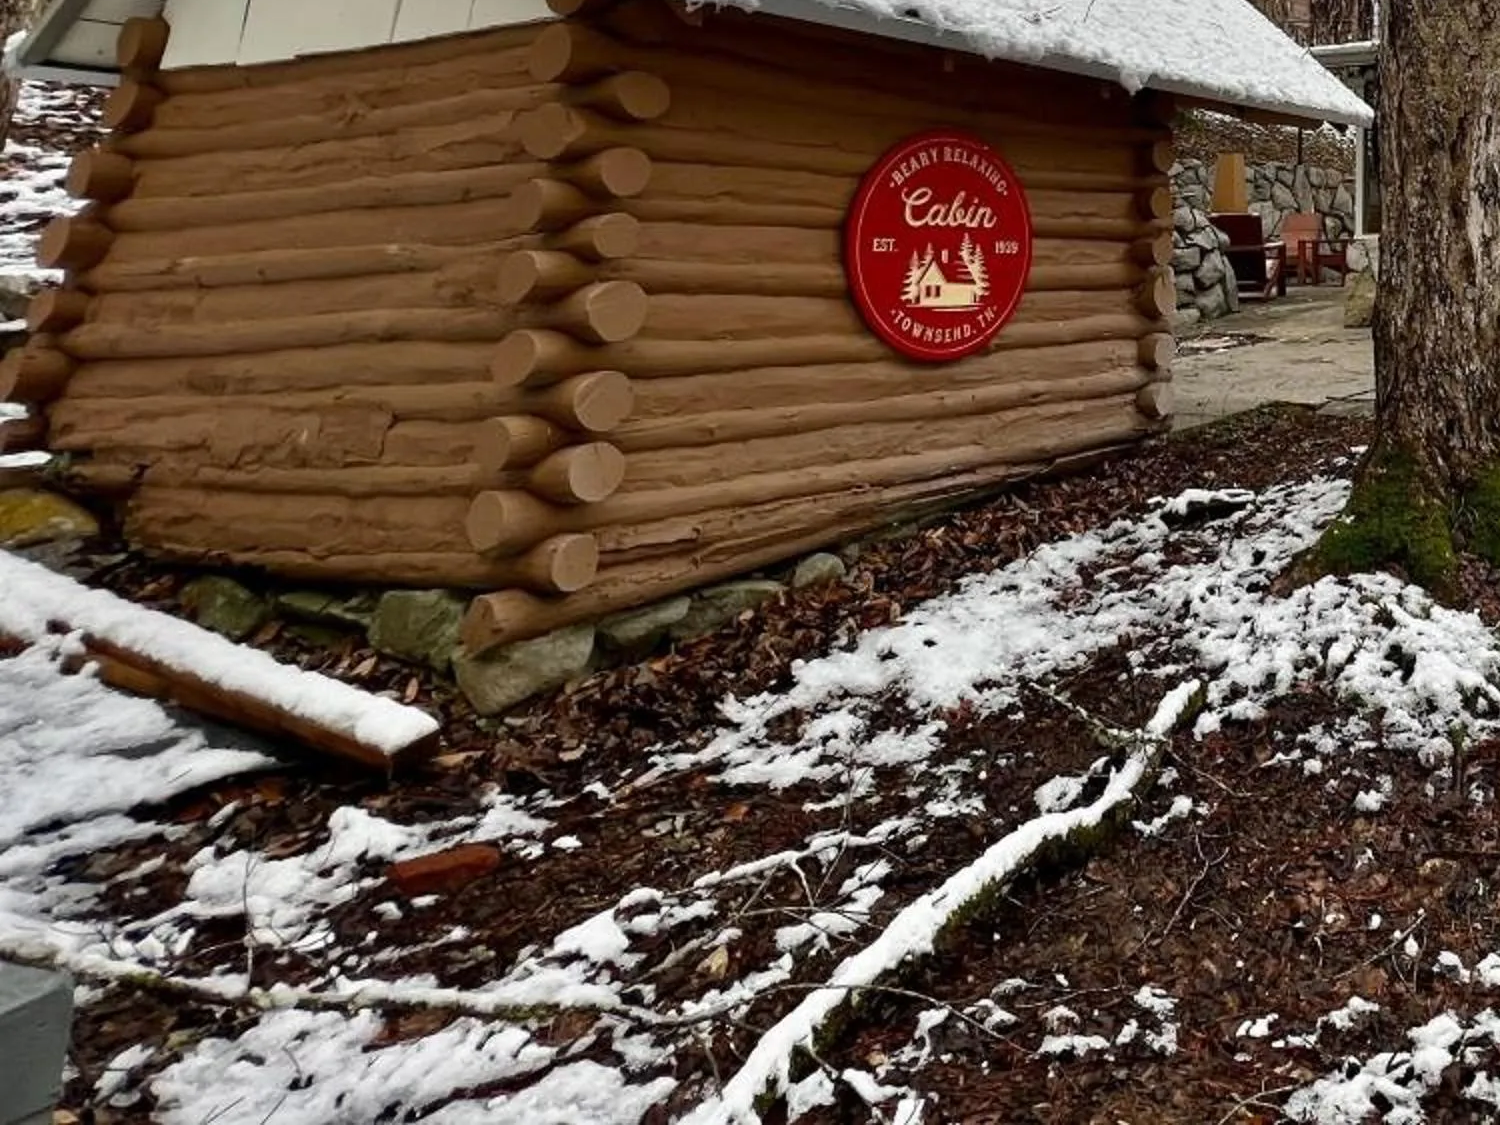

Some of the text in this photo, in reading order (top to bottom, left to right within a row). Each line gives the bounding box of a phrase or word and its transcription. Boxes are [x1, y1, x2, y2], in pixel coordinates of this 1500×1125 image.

[892, 146, 1007, 192] BEARY RELAXING
[901, 187, 997, 228] Cabin
[872, 238, 898, 252] EST.
[976, 306, 995, 328] TN
